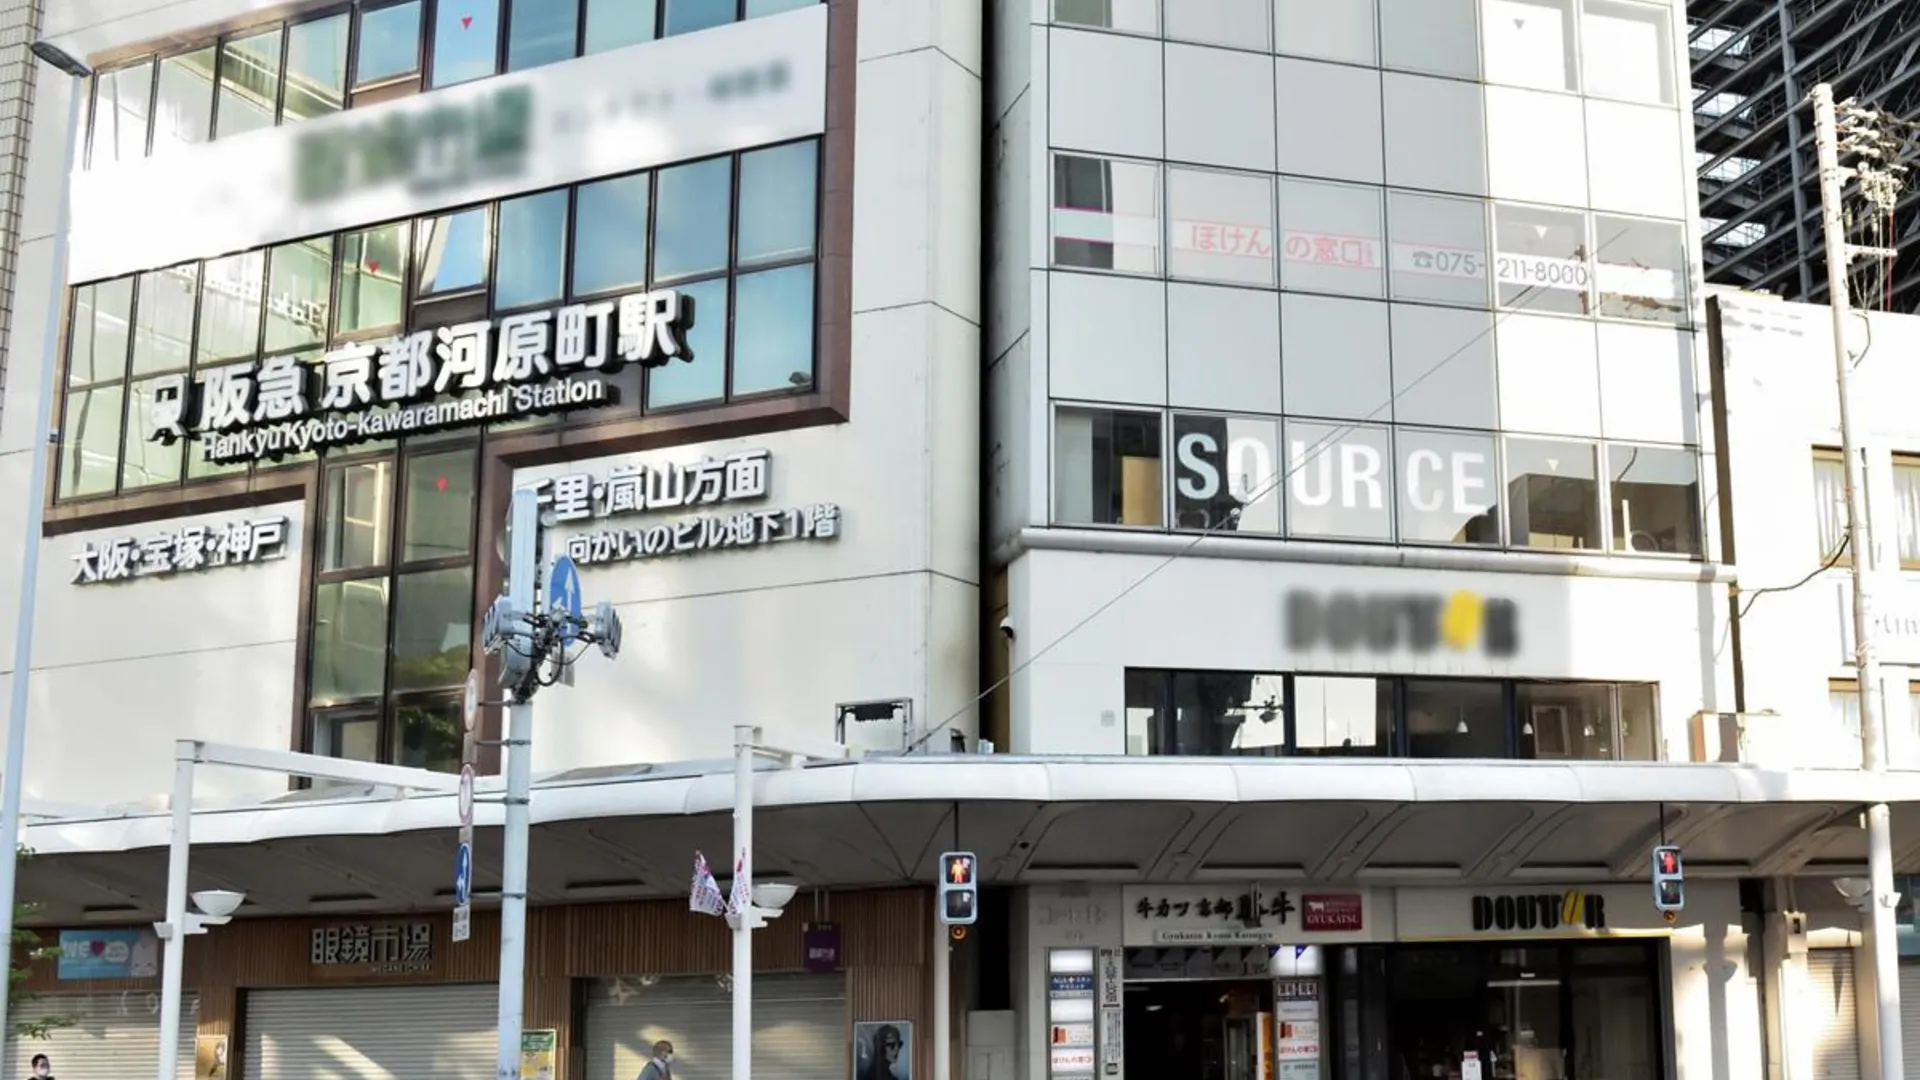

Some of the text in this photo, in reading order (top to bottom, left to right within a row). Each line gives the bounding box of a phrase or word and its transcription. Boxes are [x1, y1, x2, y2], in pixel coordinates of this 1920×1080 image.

[1191, 225, 1362, 266] ほけんの窓口
[204, 428, 282, 460] Hankyu
[515, 378, 602, 410] Station
[1177, 434, 1488, 515] SOURCE
[1472, 889, 1605, 930] DOUTOR
[312, 923, 431, 964] 眼鏡市場
